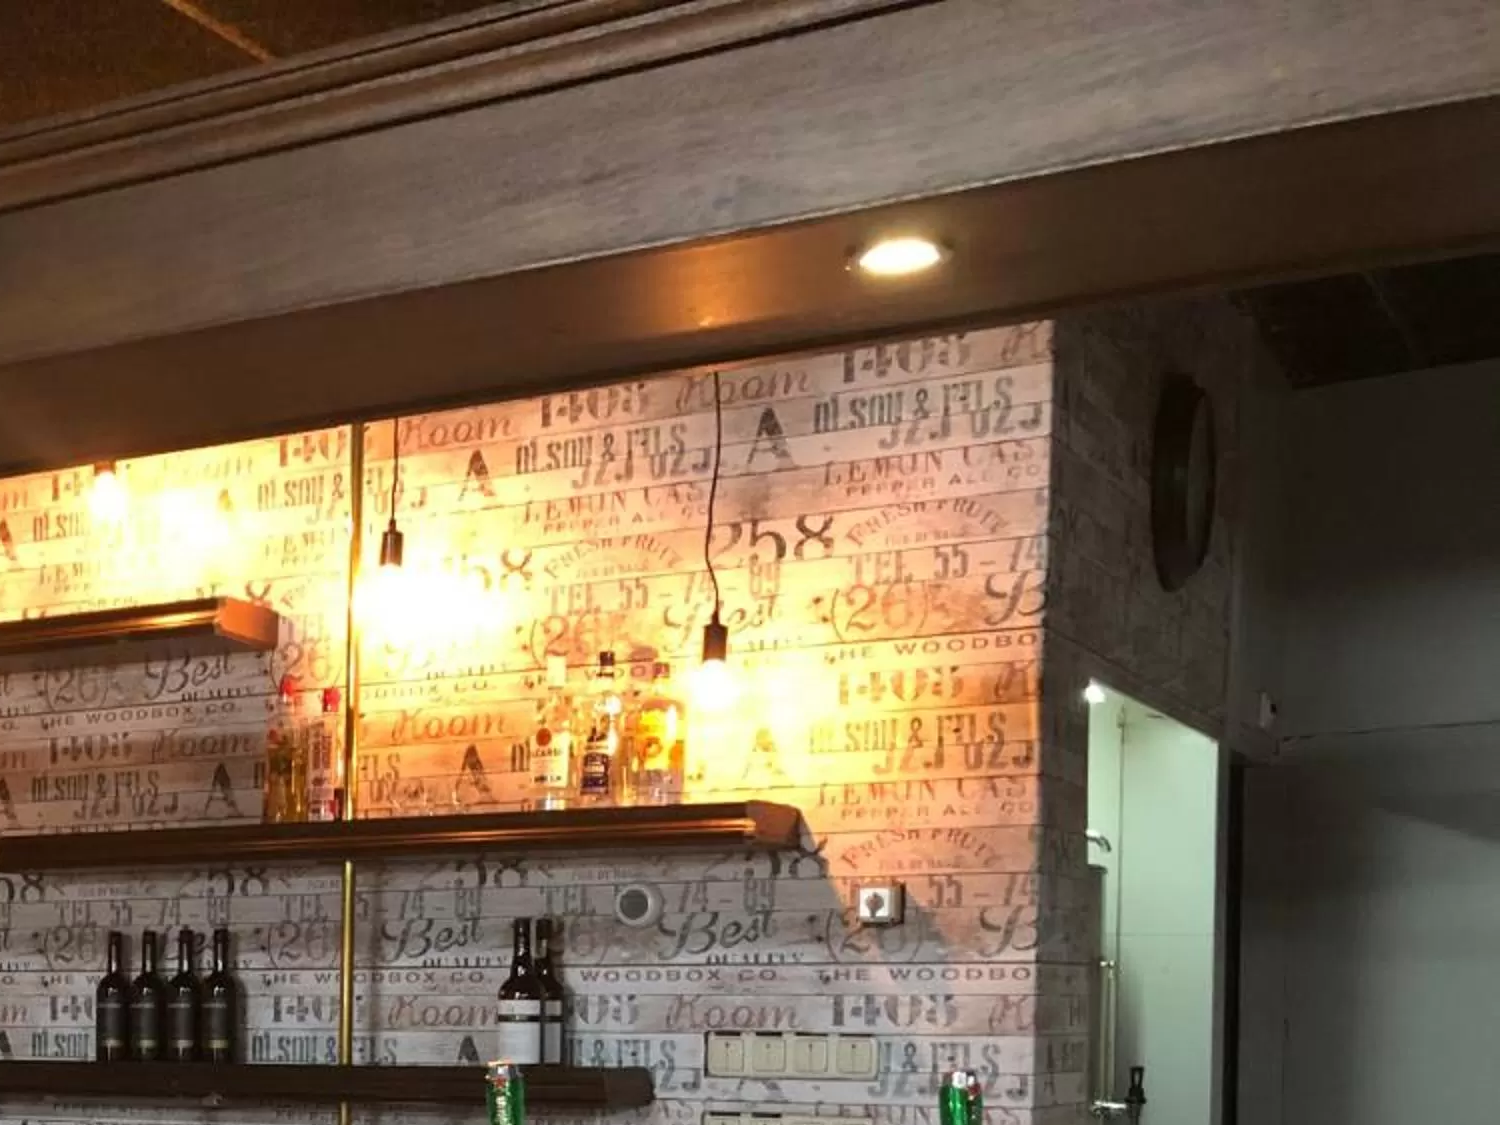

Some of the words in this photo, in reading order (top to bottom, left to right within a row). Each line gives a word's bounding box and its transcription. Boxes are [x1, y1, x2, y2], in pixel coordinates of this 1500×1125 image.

[145, 652, 238, 701] Best
[85, 705, 195, 726] WOODBOX
[204, 761, 244, 818] A
[379, 916, 485, 963] Best
[658, 908, 775, 961] Best
